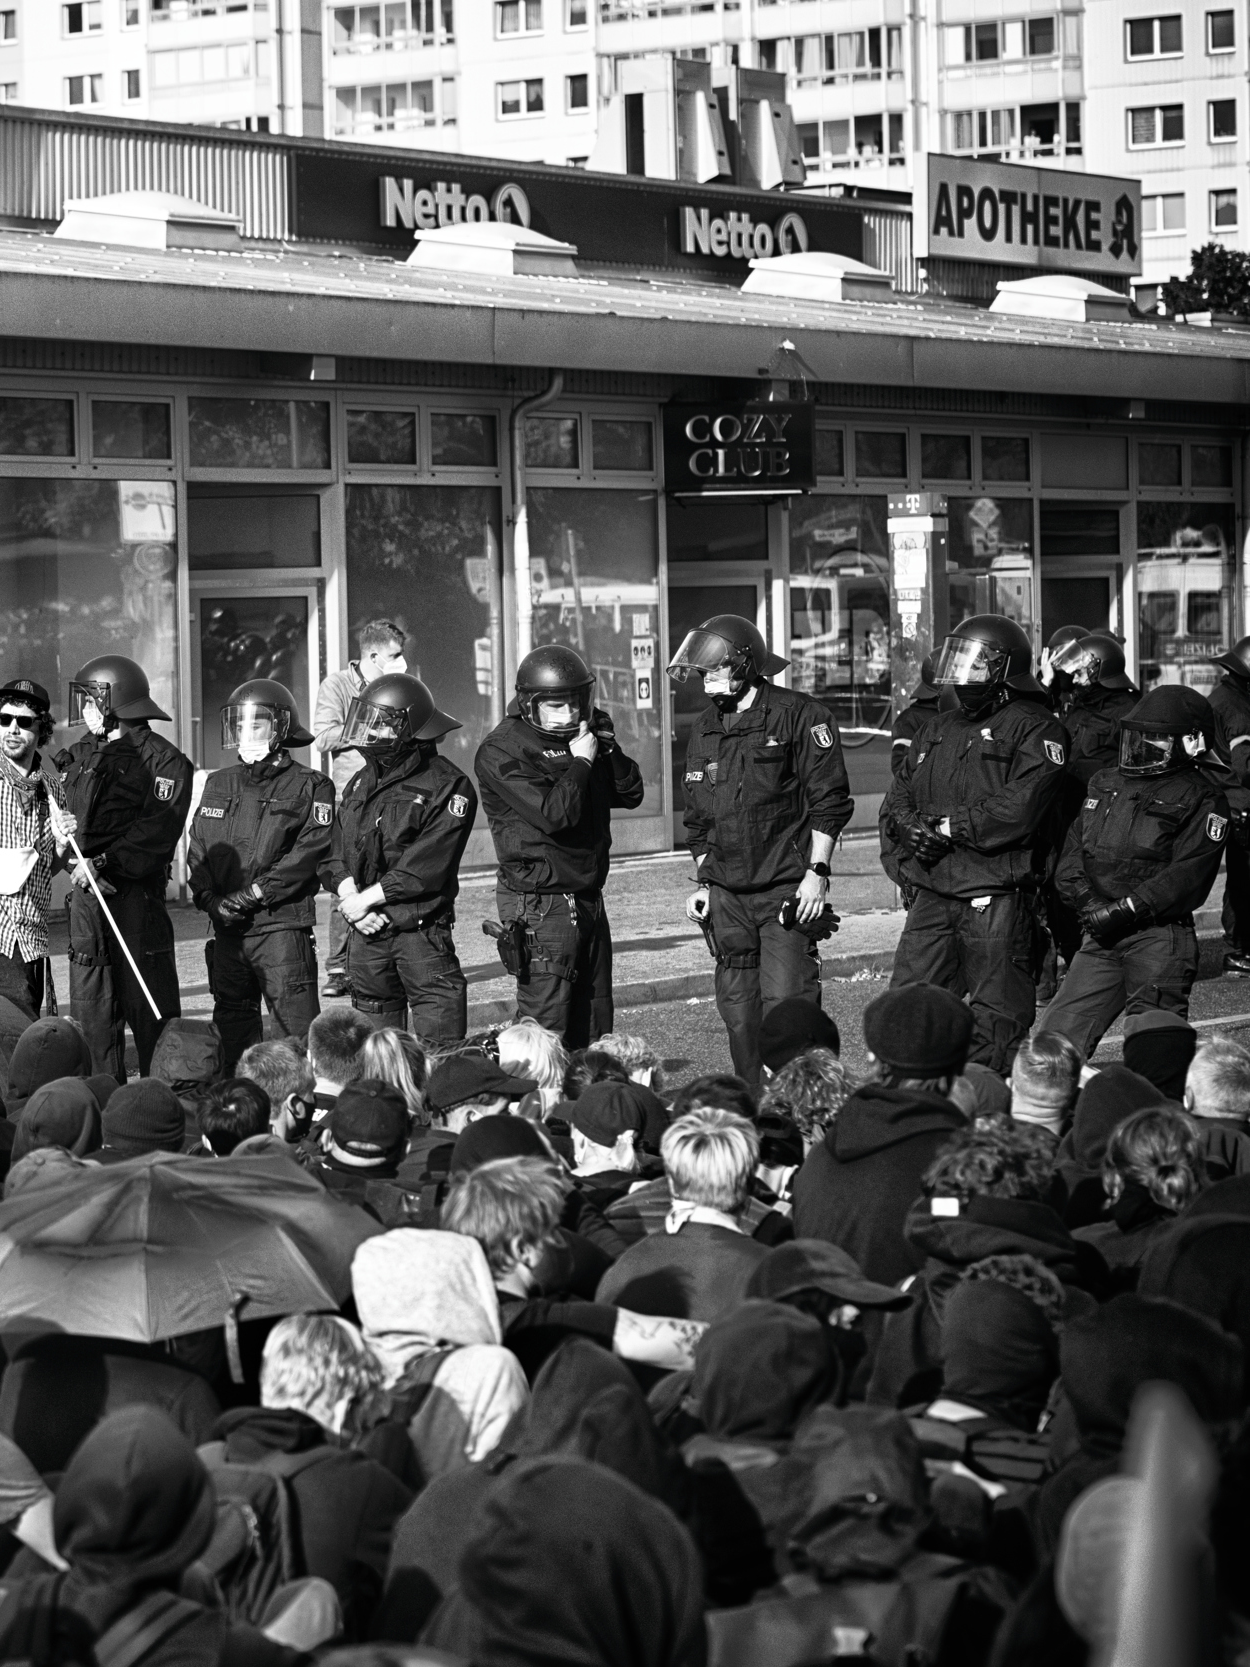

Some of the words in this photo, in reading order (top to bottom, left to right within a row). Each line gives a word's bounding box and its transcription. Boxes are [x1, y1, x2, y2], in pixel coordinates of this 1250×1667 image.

[379, 176, 489, 229] Netto
[932, 181, 1102, 253] APOTHEKE
[680, 206, 774, 258] Netto
[685, 414, 792, 443] COZY
[689, 448, 790, 477] CLUB
[200, 806, 224, 818] POLIZEI
